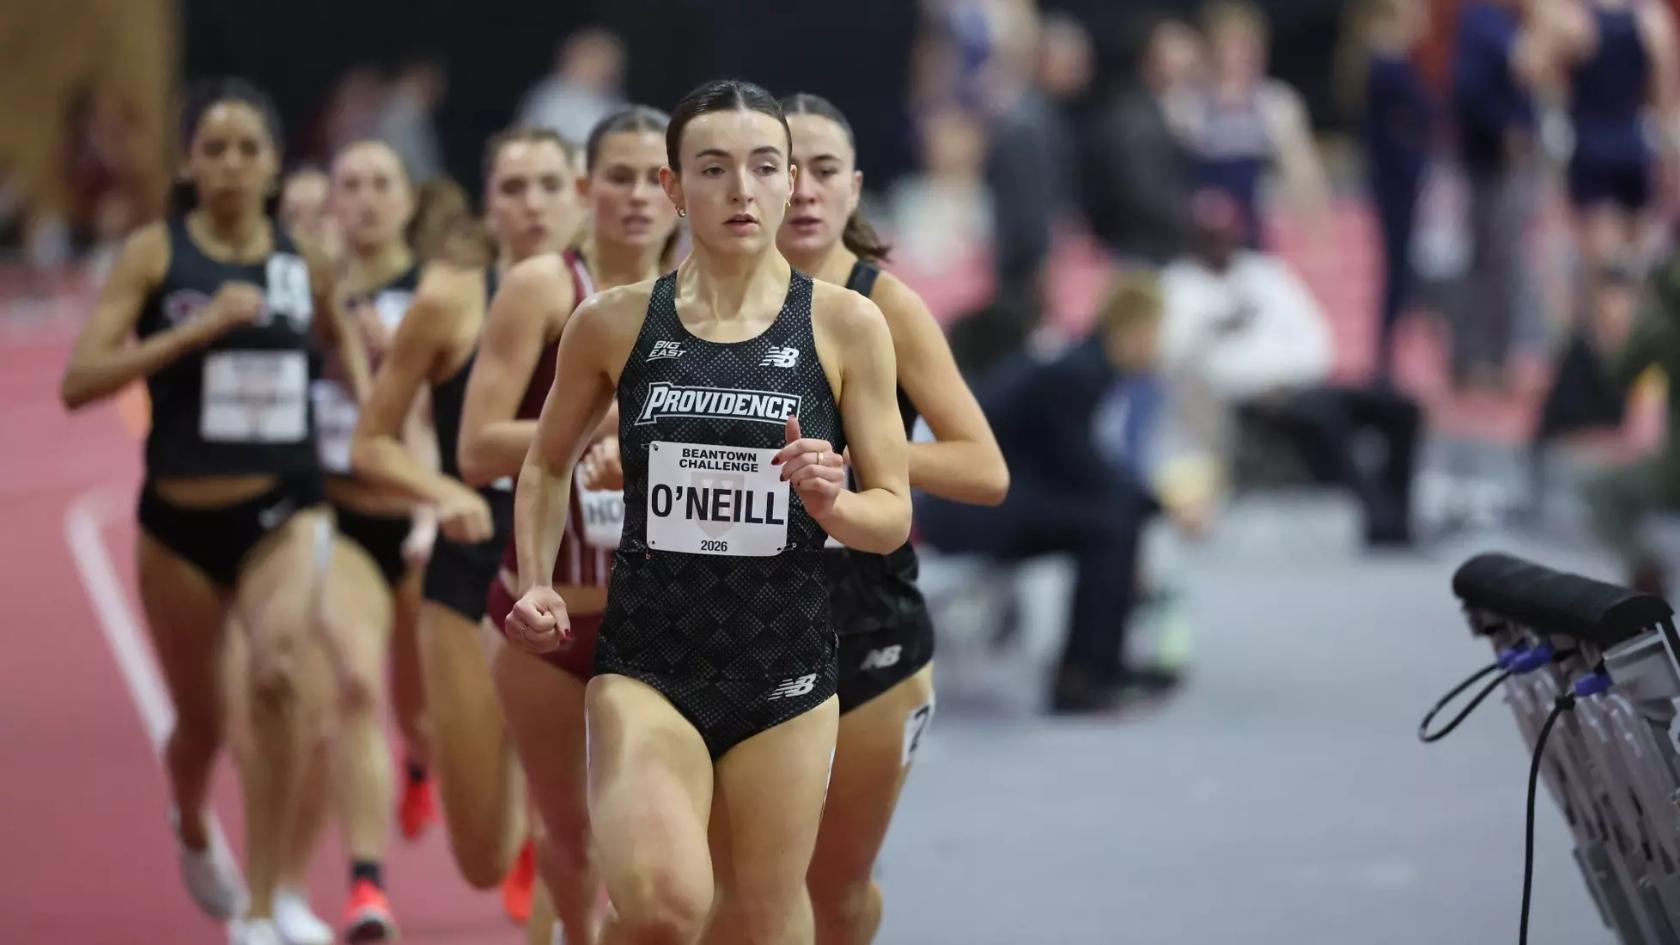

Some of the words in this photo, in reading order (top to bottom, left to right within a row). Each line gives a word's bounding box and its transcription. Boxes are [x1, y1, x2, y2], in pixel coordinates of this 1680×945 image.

[653, 340, 681, 349] BIG
[648, 349, 687, 358] EAST
[642, 386, 797, 420] PROVIDENCE
[682, 448, 757, 462] BEANTOWN
[679, 459, 759, 473] CHALLENGE
[651, 483, 785, 526] O’NEILL
[700, 540, 728, 552] 2026
